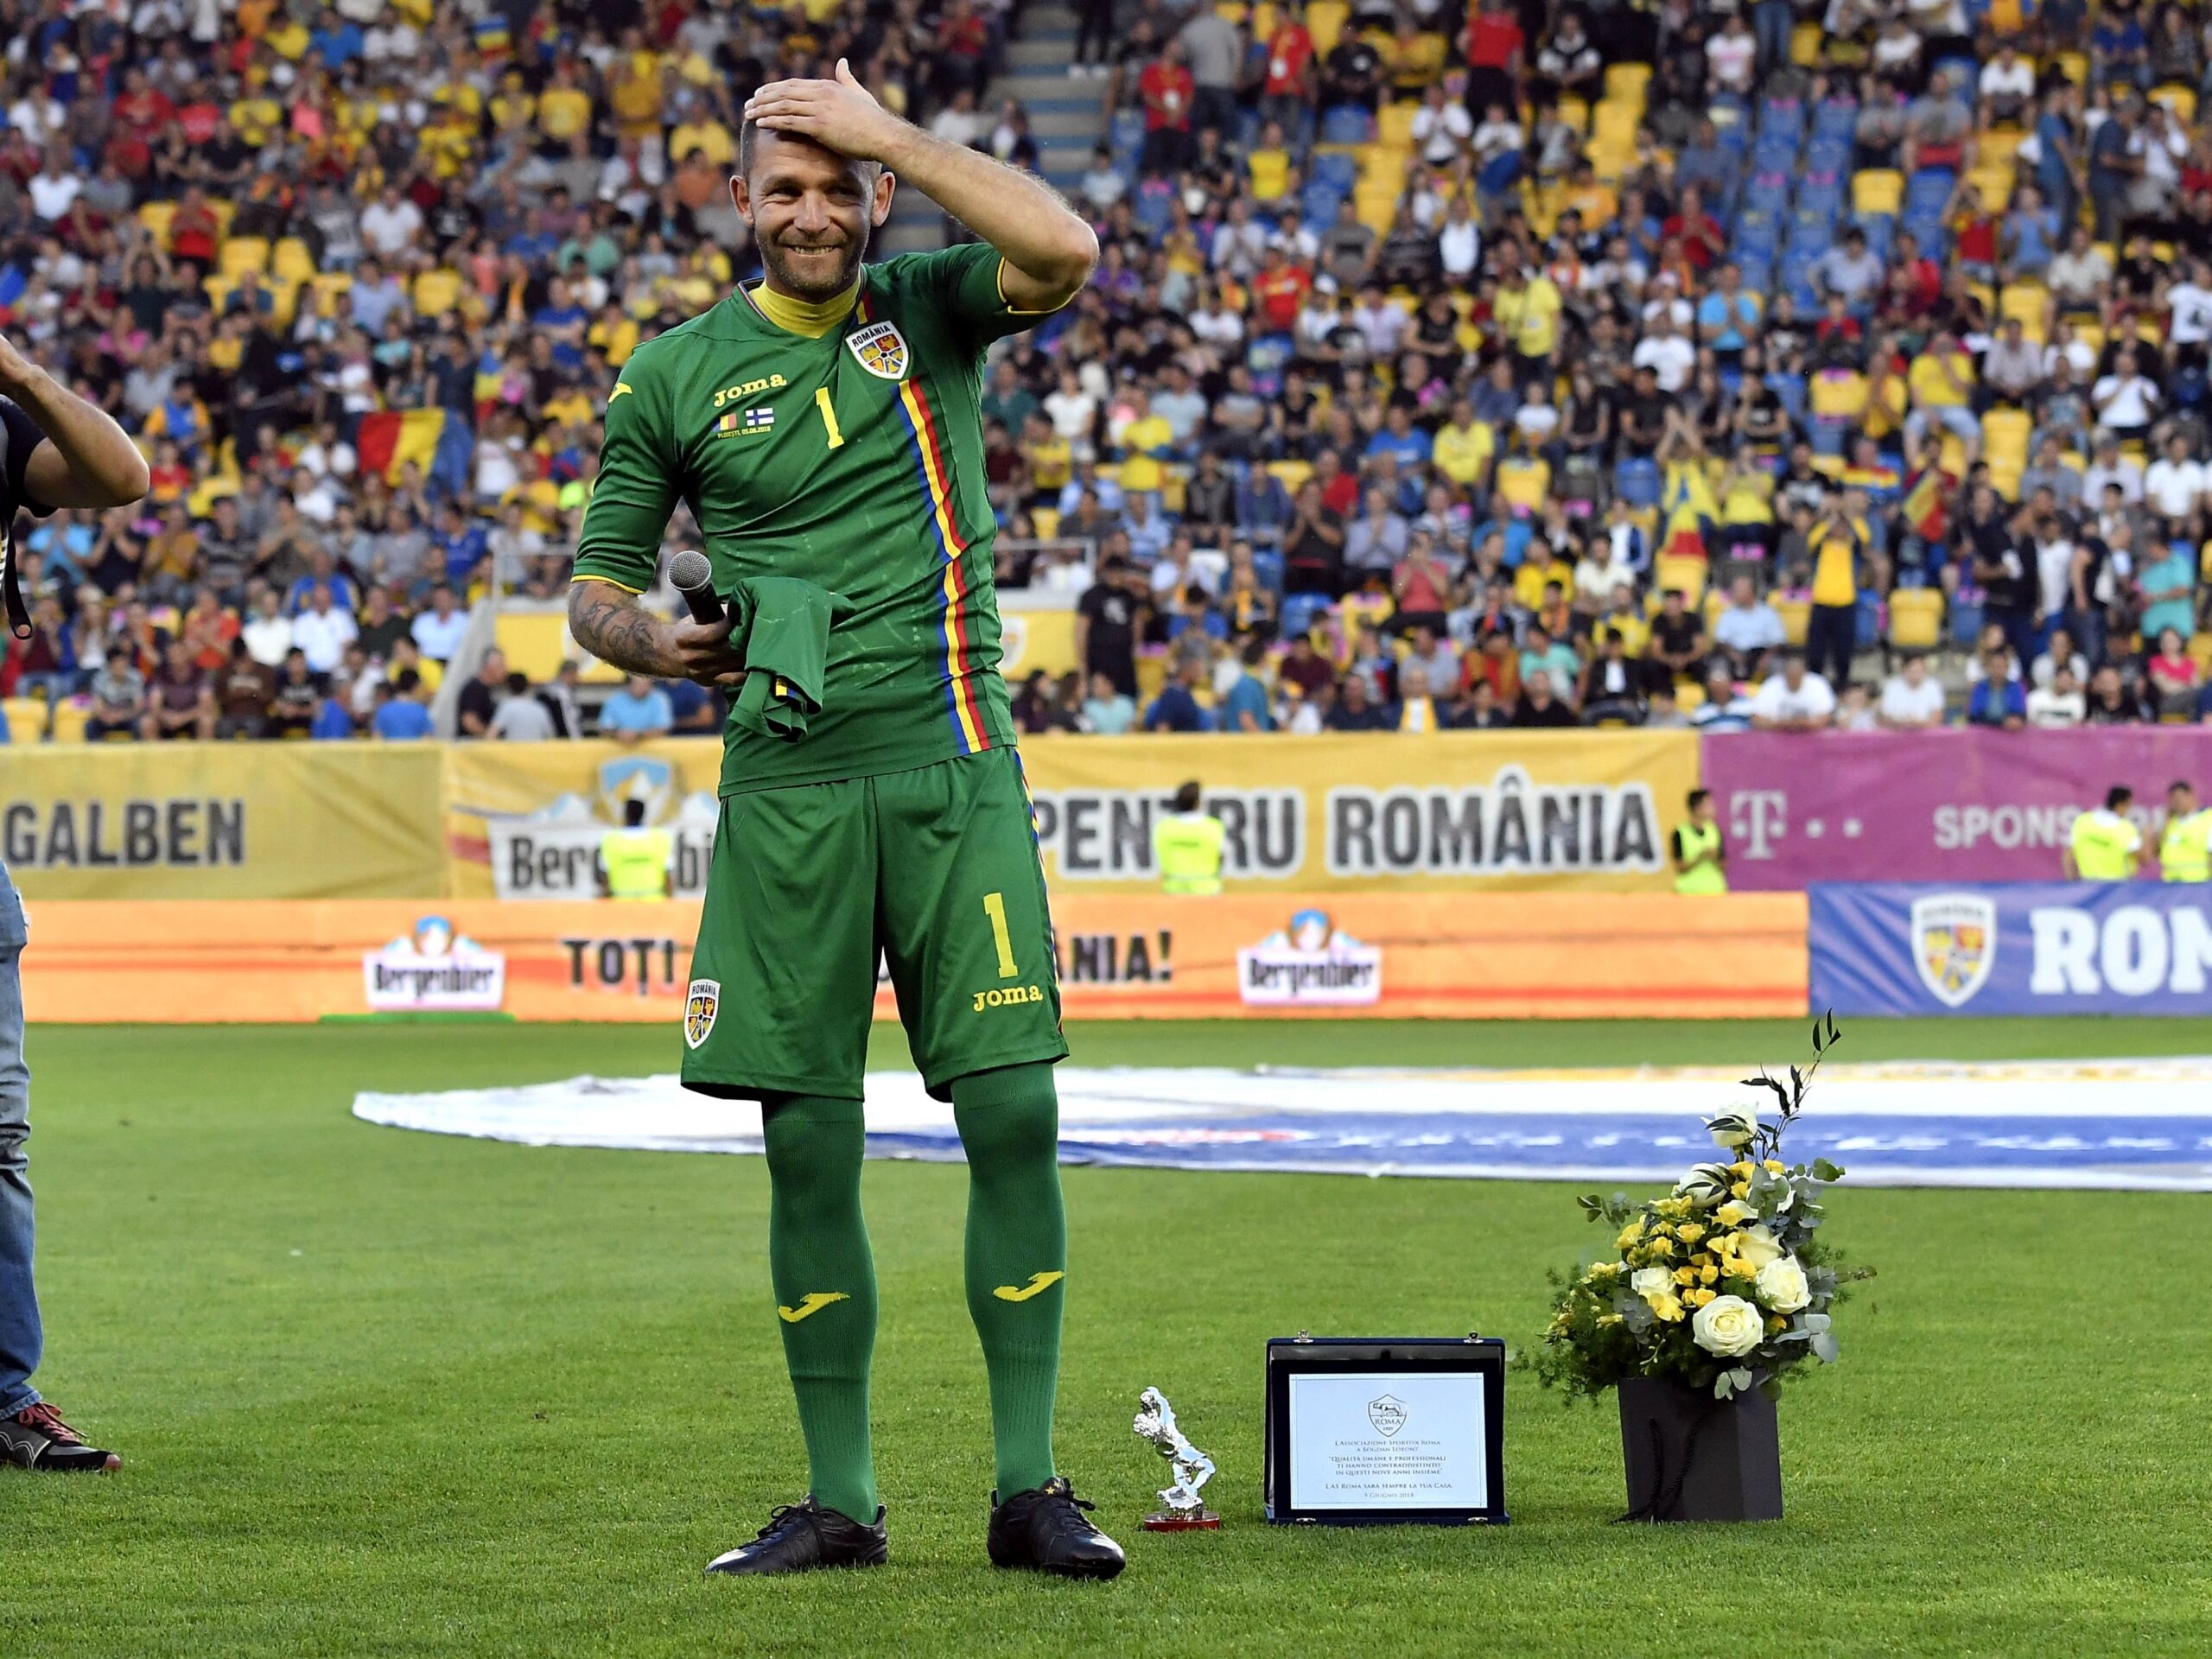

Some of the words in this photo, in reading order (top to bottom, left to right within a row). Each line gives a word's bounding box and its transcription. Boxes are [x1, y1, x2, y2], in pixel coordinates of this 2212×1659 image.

[851, 325, 891, 347] ROMÂNIA
[815, 387, 845, 449] 1
[3, 799, 245, 865] GALBEN
[1336, 772, 1655, 867] ROMÂNIA
[982, 892, 1019, 979] 1
[691, 982, 715, 995] ROMÂNIA
